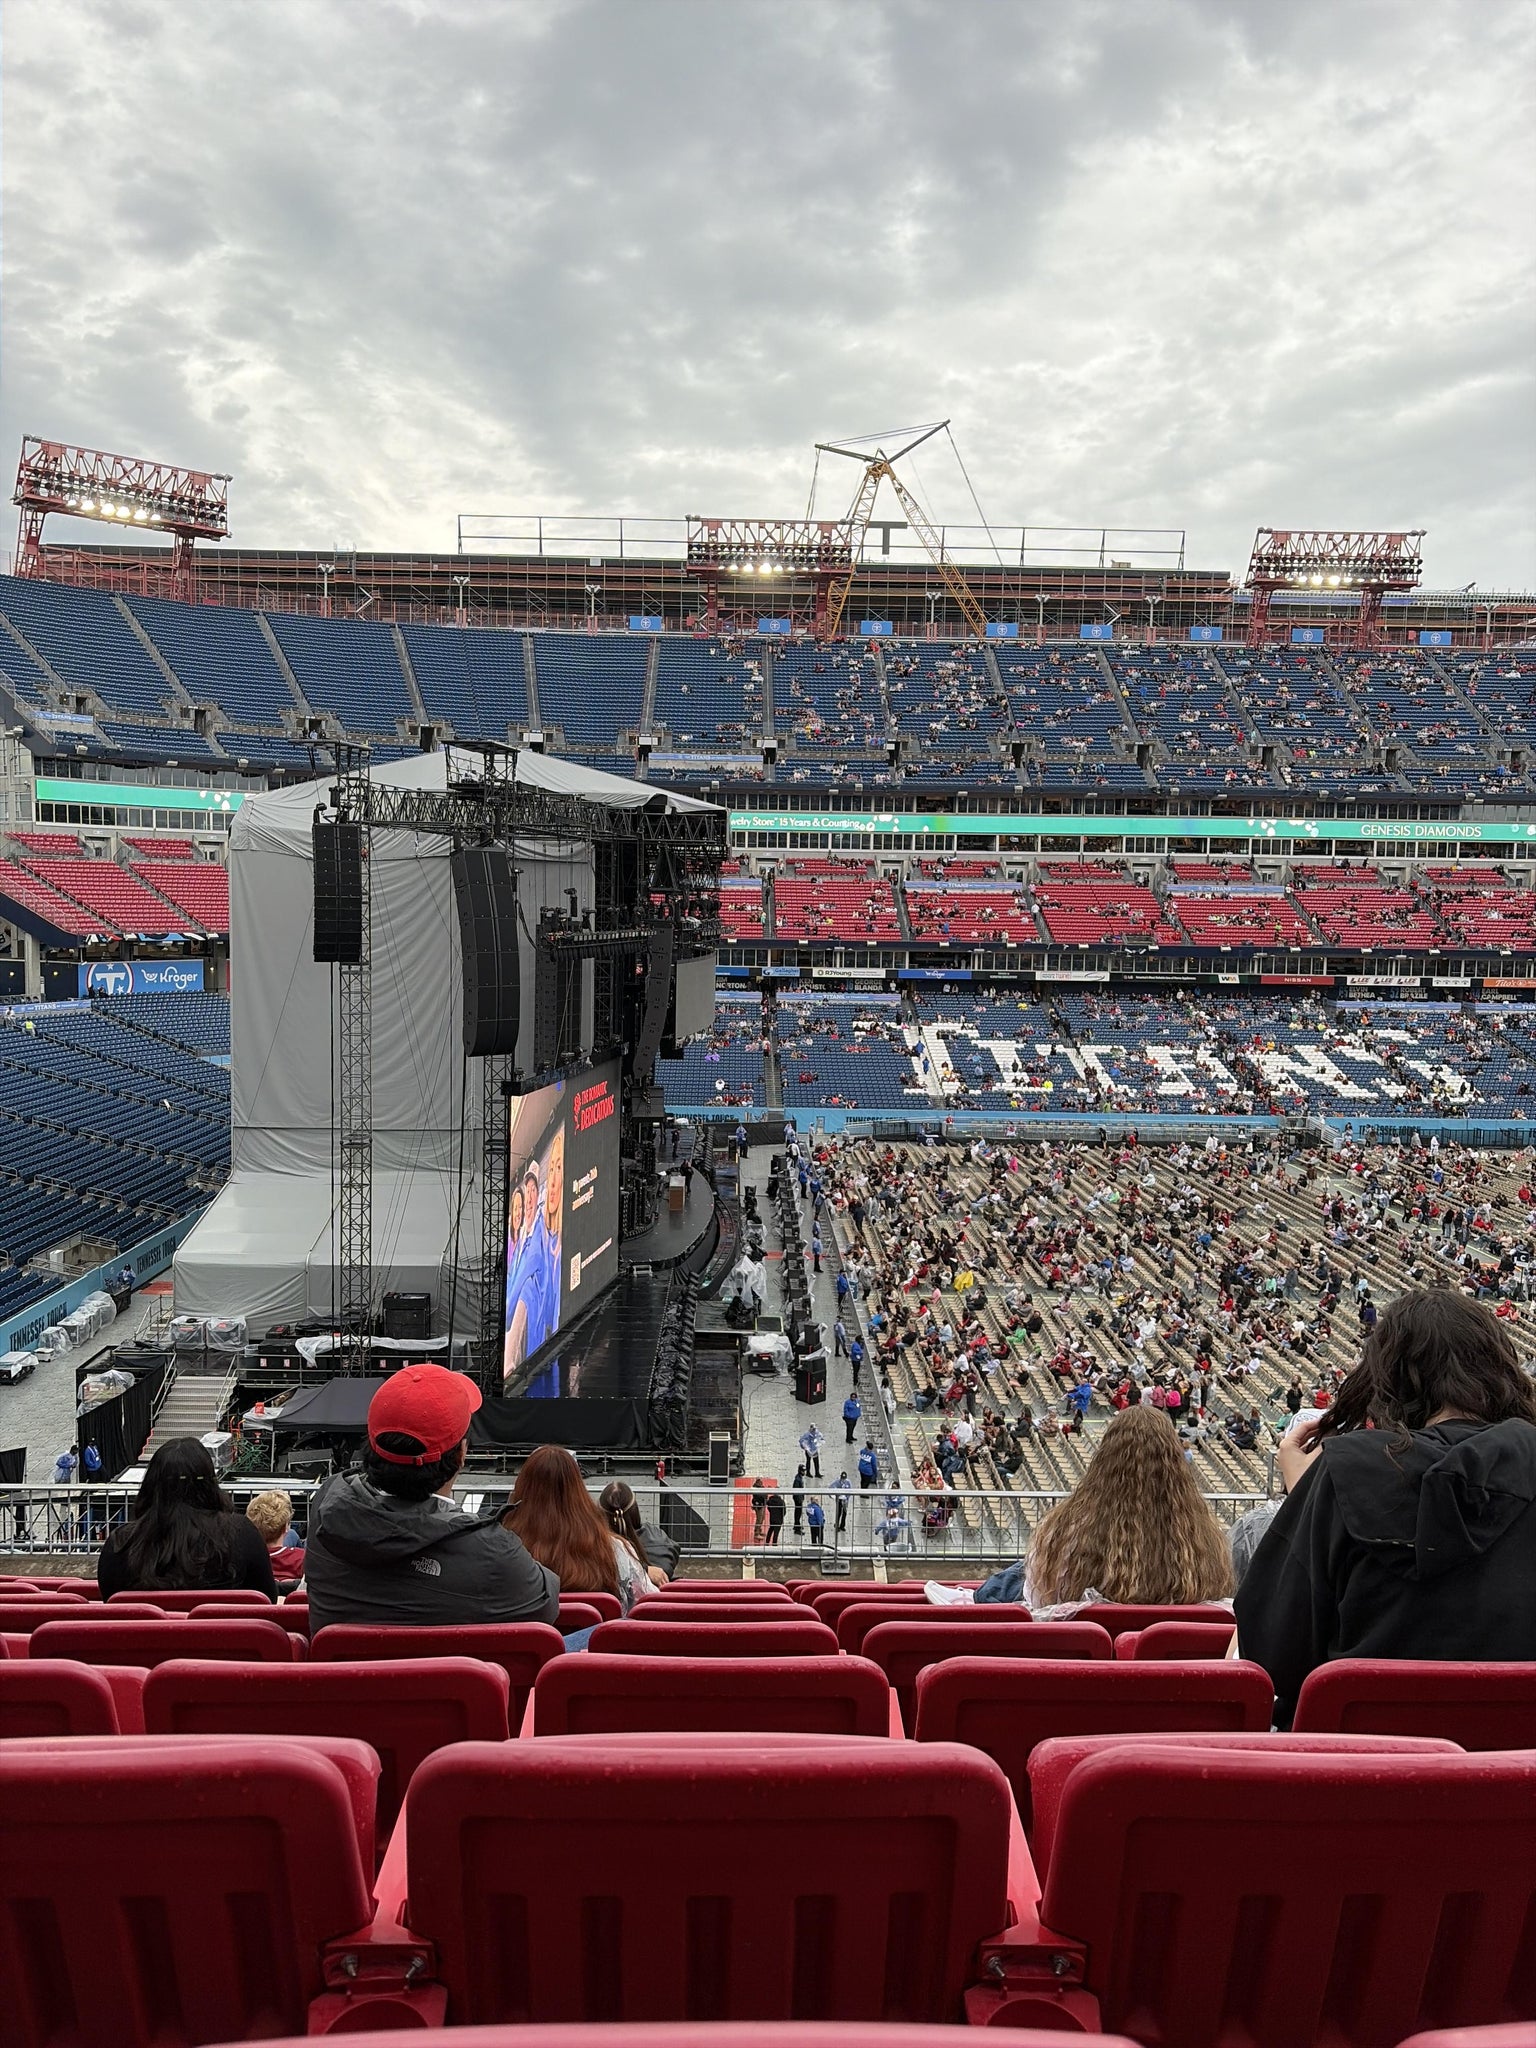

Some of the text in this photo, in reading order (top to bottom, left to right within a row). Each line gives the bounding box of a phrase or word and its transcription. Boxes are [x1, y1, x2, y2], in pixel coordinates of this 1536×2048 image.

[780, 818, 788, 826] 15
[789, 818, 811, 826] Years
[812, 818, 820, 827] &
[821, 818, 860, 829] Counting
[1361, 824, 1482, 838] GENESIS DIAMONDS
[160, 966, 198, 989] Kroger
[34, 1003, 56, 1011] TITANS
[580, 1094, 614, 1131] DEDICATIONS
[136, 1236, 176, 1275] TENNESSEE TOUGH
[10, 1314, 45, 1350] TENNESSEE
